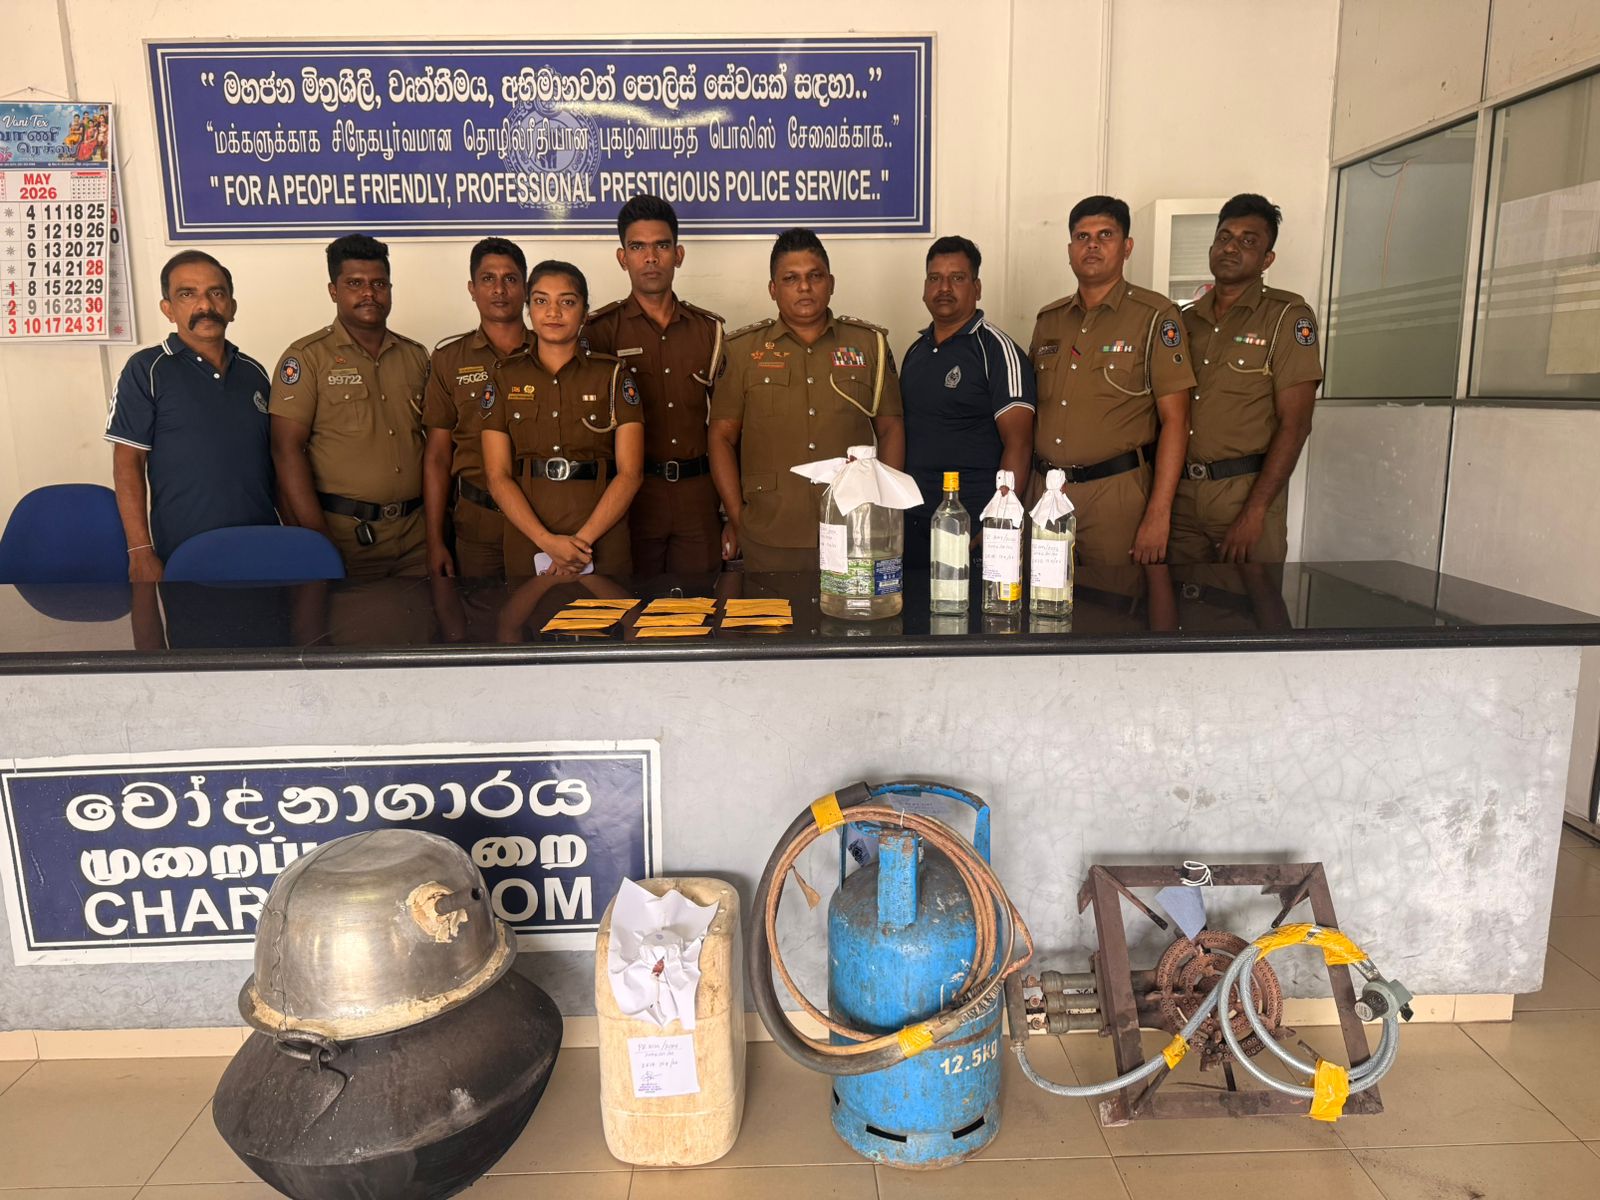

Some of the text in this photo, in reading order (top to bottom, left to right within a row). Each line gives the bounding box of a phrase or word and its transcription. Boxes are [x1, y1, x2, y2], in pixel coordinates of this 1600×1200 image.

[223, 70, 296, 105] මහජන
[501, 64, 617, 108] අභිමානවත්
[622, 63, 697, 111] පොලිස්
[703, 62, 788, 101] සේවයක්
[3, 114, 49, 128] Vani Tex
[708, 115, 776, 150] பொலிஸ்
[23, 173, 52, 185] MAY
[19, 187, 58, 200] 2026
[224, 174, 263, 206] FOR
[267, 175, 281, 205] A
[283, 173, 357, 205] PEOPLE
[360, 172, 452, 209] FRIENDLY,
[455, 171, 597, 204] PROFESSIONAL
[600, 170, 721, 203] PRESTIGIOUS
[725, 169, 790, 202] POLICE
[26, 203, 105, 221] 4 11 18 25
[27, 222, 105, 240] 5 12 19 26
[27, 240, 104, 259] 6 13 20 27
[27, 259, 104, 278] 7 14 21 28
[9, 278, 104, 297] 1 8 15 22 29
[7, 297, 103, 316] 2 9 16 23 30
[8, 315, 103, 335] 3 10 17 24 31
[327, 375, 363, 386] 99722
[455, 371, 489, 386] 75026
[80, 833, 588, 886] முறைப் றை
[83, 876, 593, 936] CHAR OM
